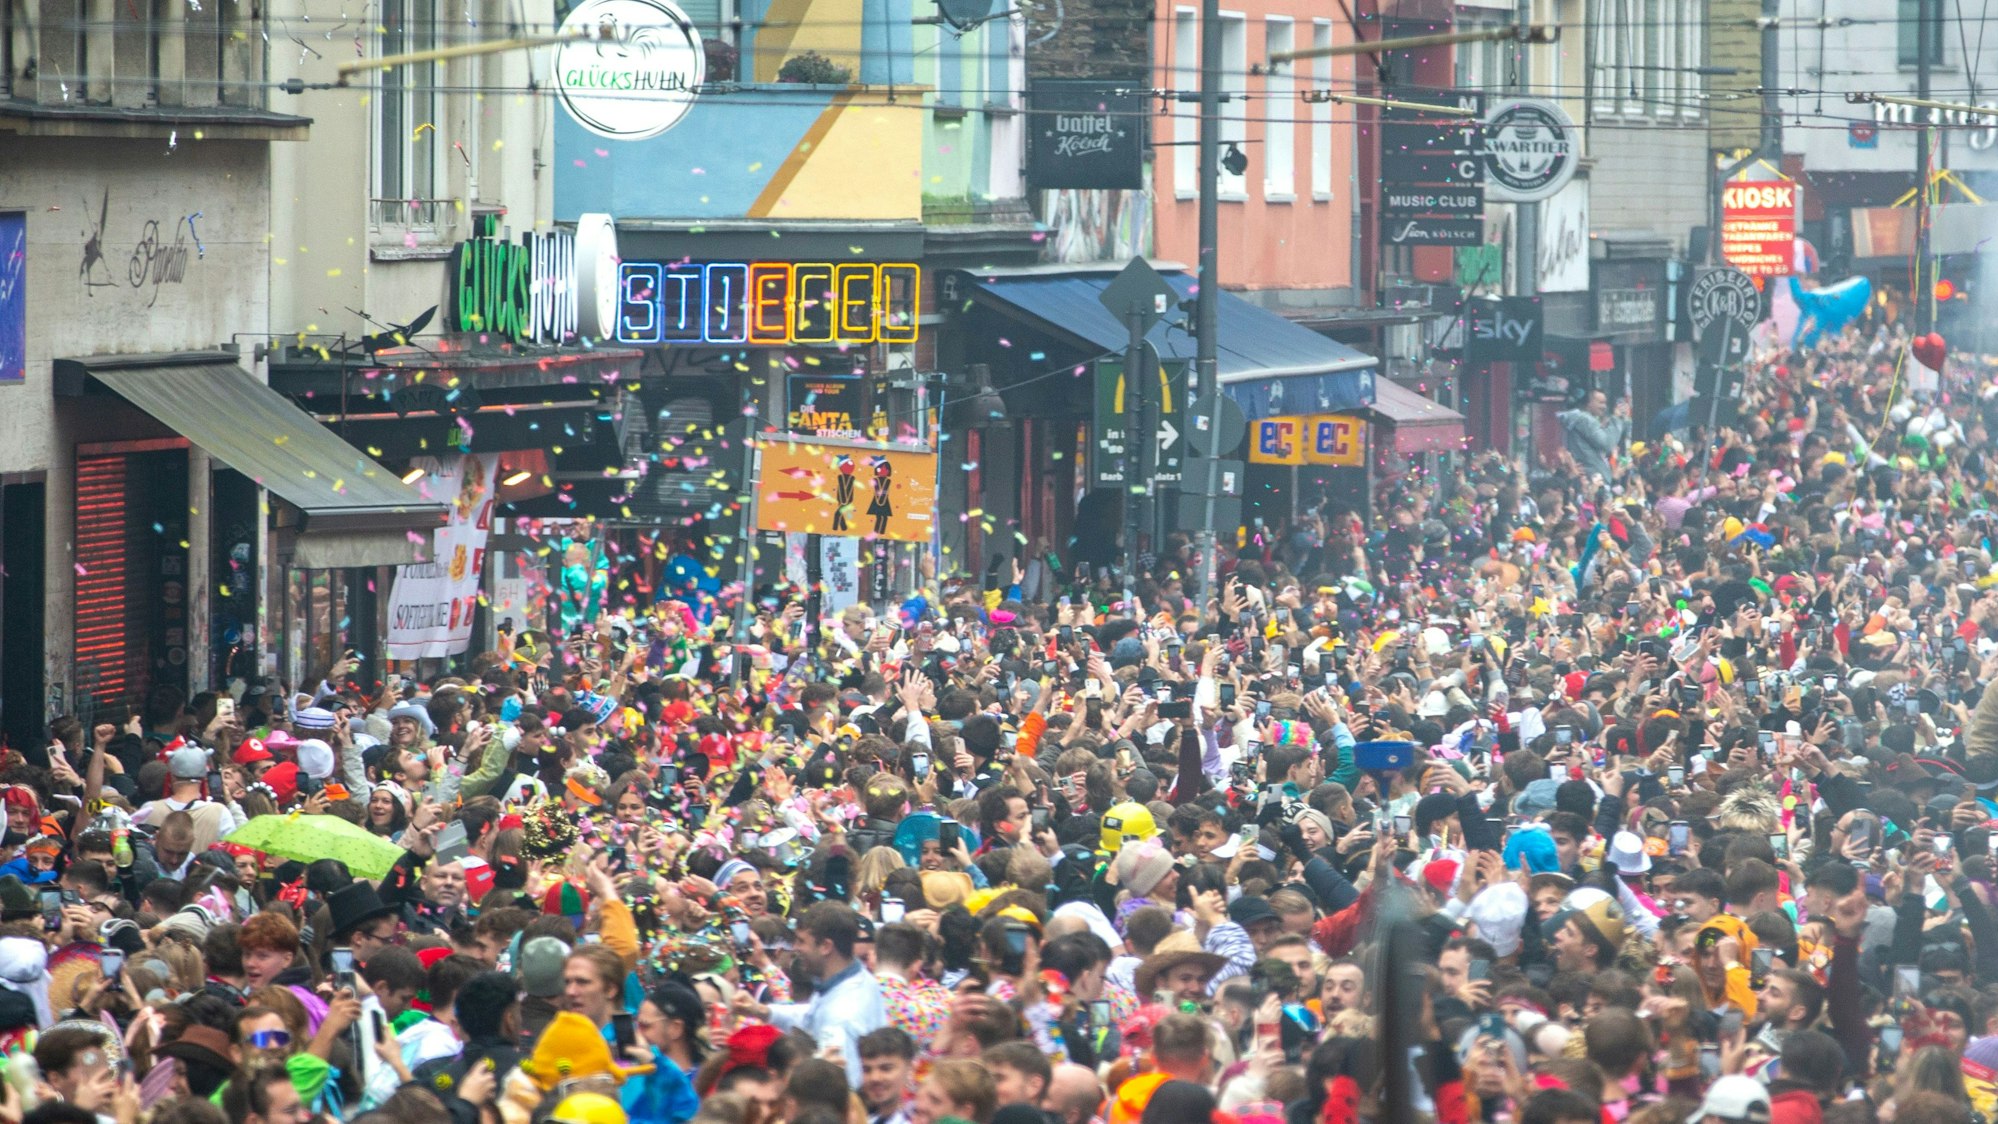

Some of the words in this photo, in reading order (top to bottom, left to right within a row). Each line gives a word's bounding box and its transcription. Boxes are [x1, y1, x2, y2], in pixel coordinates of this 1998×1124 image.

[566, 64, 685, 90] GLÜCKSHUHN
[1389, 195, 1436, 207] MUSIC
[1438, 195, 1477, 207] CLUB
[1723, 187, 1793, 209] KIOSK
[1432, 230, 1476, 239] KÖLSCH
[459, 213, 580, 345] GLÜCKSHUHN
[1475, 311, 1534, 346] sky
[800, 404, 815, 413] DIE
[788, 411, 853, 431] FANTA
